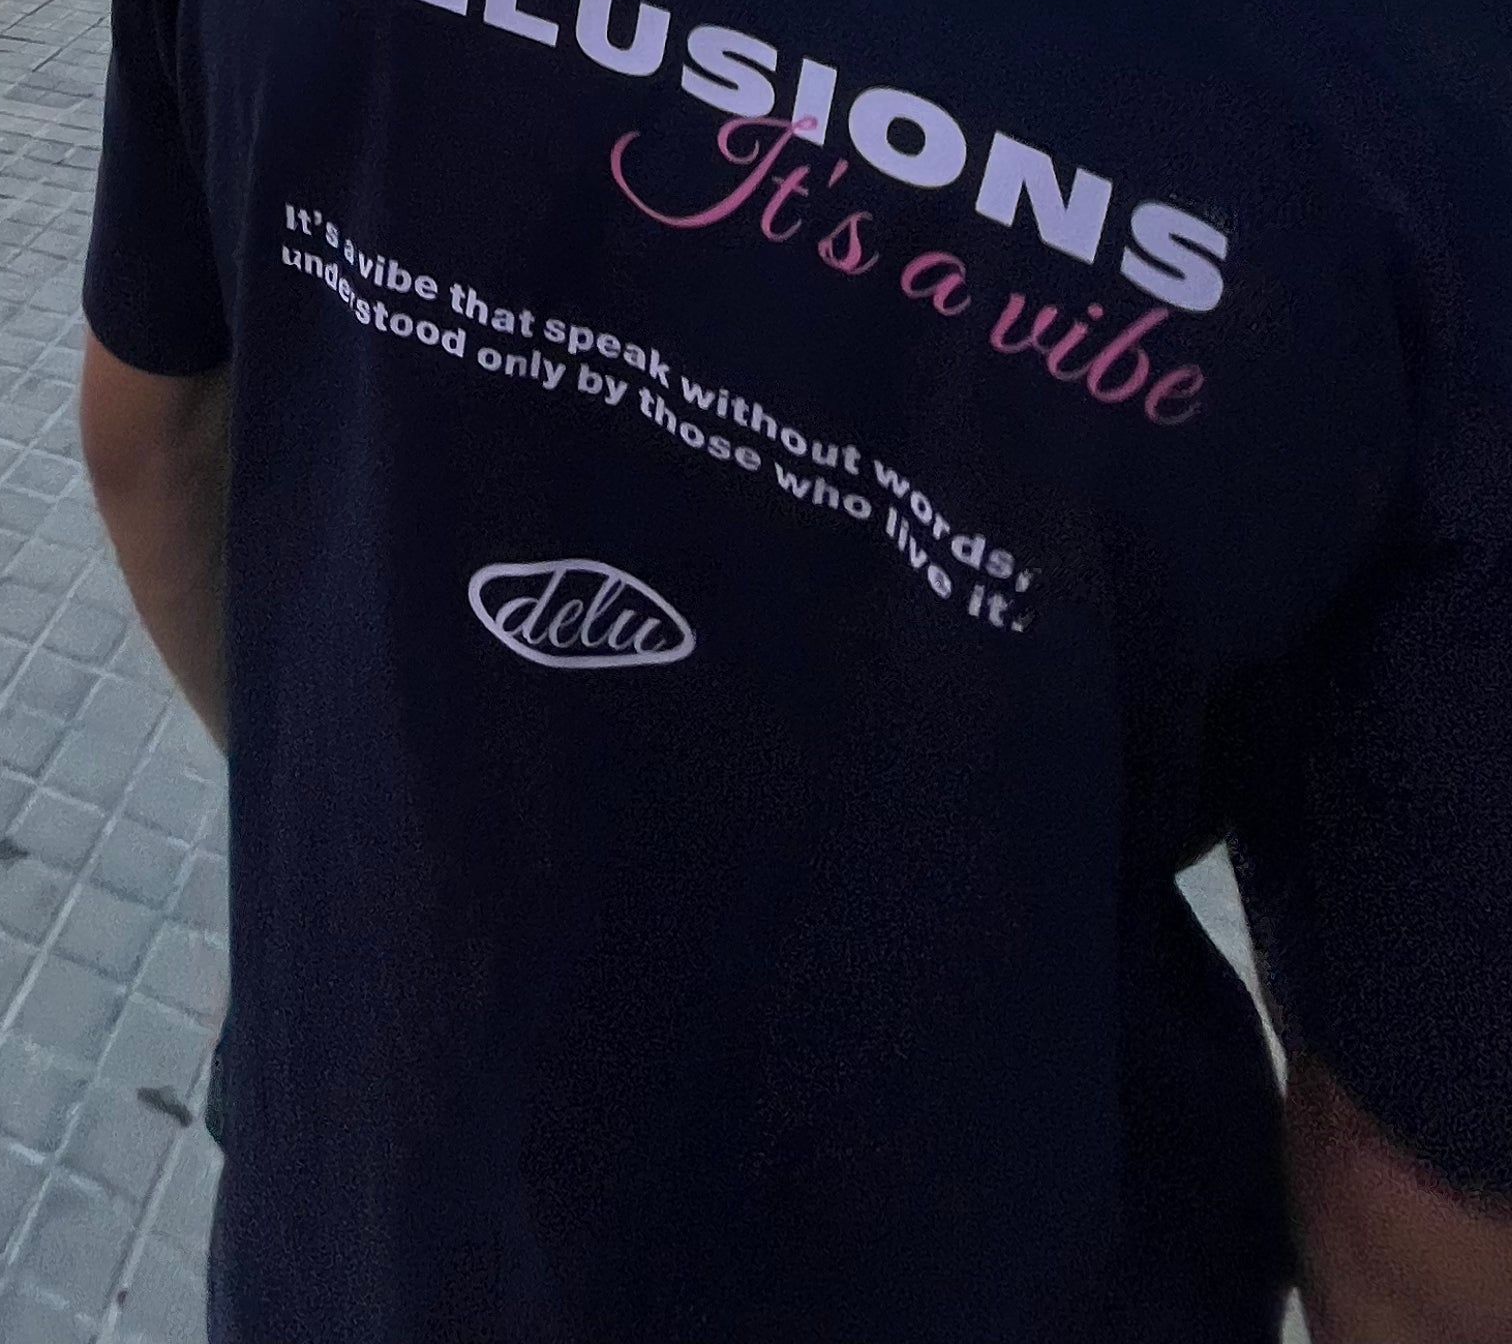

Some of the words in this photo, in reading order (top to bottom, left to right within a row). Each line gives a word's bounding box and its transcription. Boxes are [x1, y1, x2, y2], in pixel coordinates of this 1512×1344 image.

[282, 244, 467, 359] understood
[476, 347, 567, 391] only
[577, 364, 629, 406] by
[638, 386, 762, 472] those
[774, 461, 873, 520] who
[887, 506, 953, 601] live
[968, 584, 1025, 633] it.
[285, 202, 339, 249] It's
[343, 238, 356, 266] a
[358, 254, 439, 301] vibe
[449, 281, 536, 339] that
[543, 317, 671, 390] speak
[681, 375, 862, 476] without
[873, 459, 1033, 593] words,
[610, 115, 881, 275] It's
[900, 250, 972, 316] a
[988, 291, 1205, 427] vibe
[494, 567, 668, 654] delu
